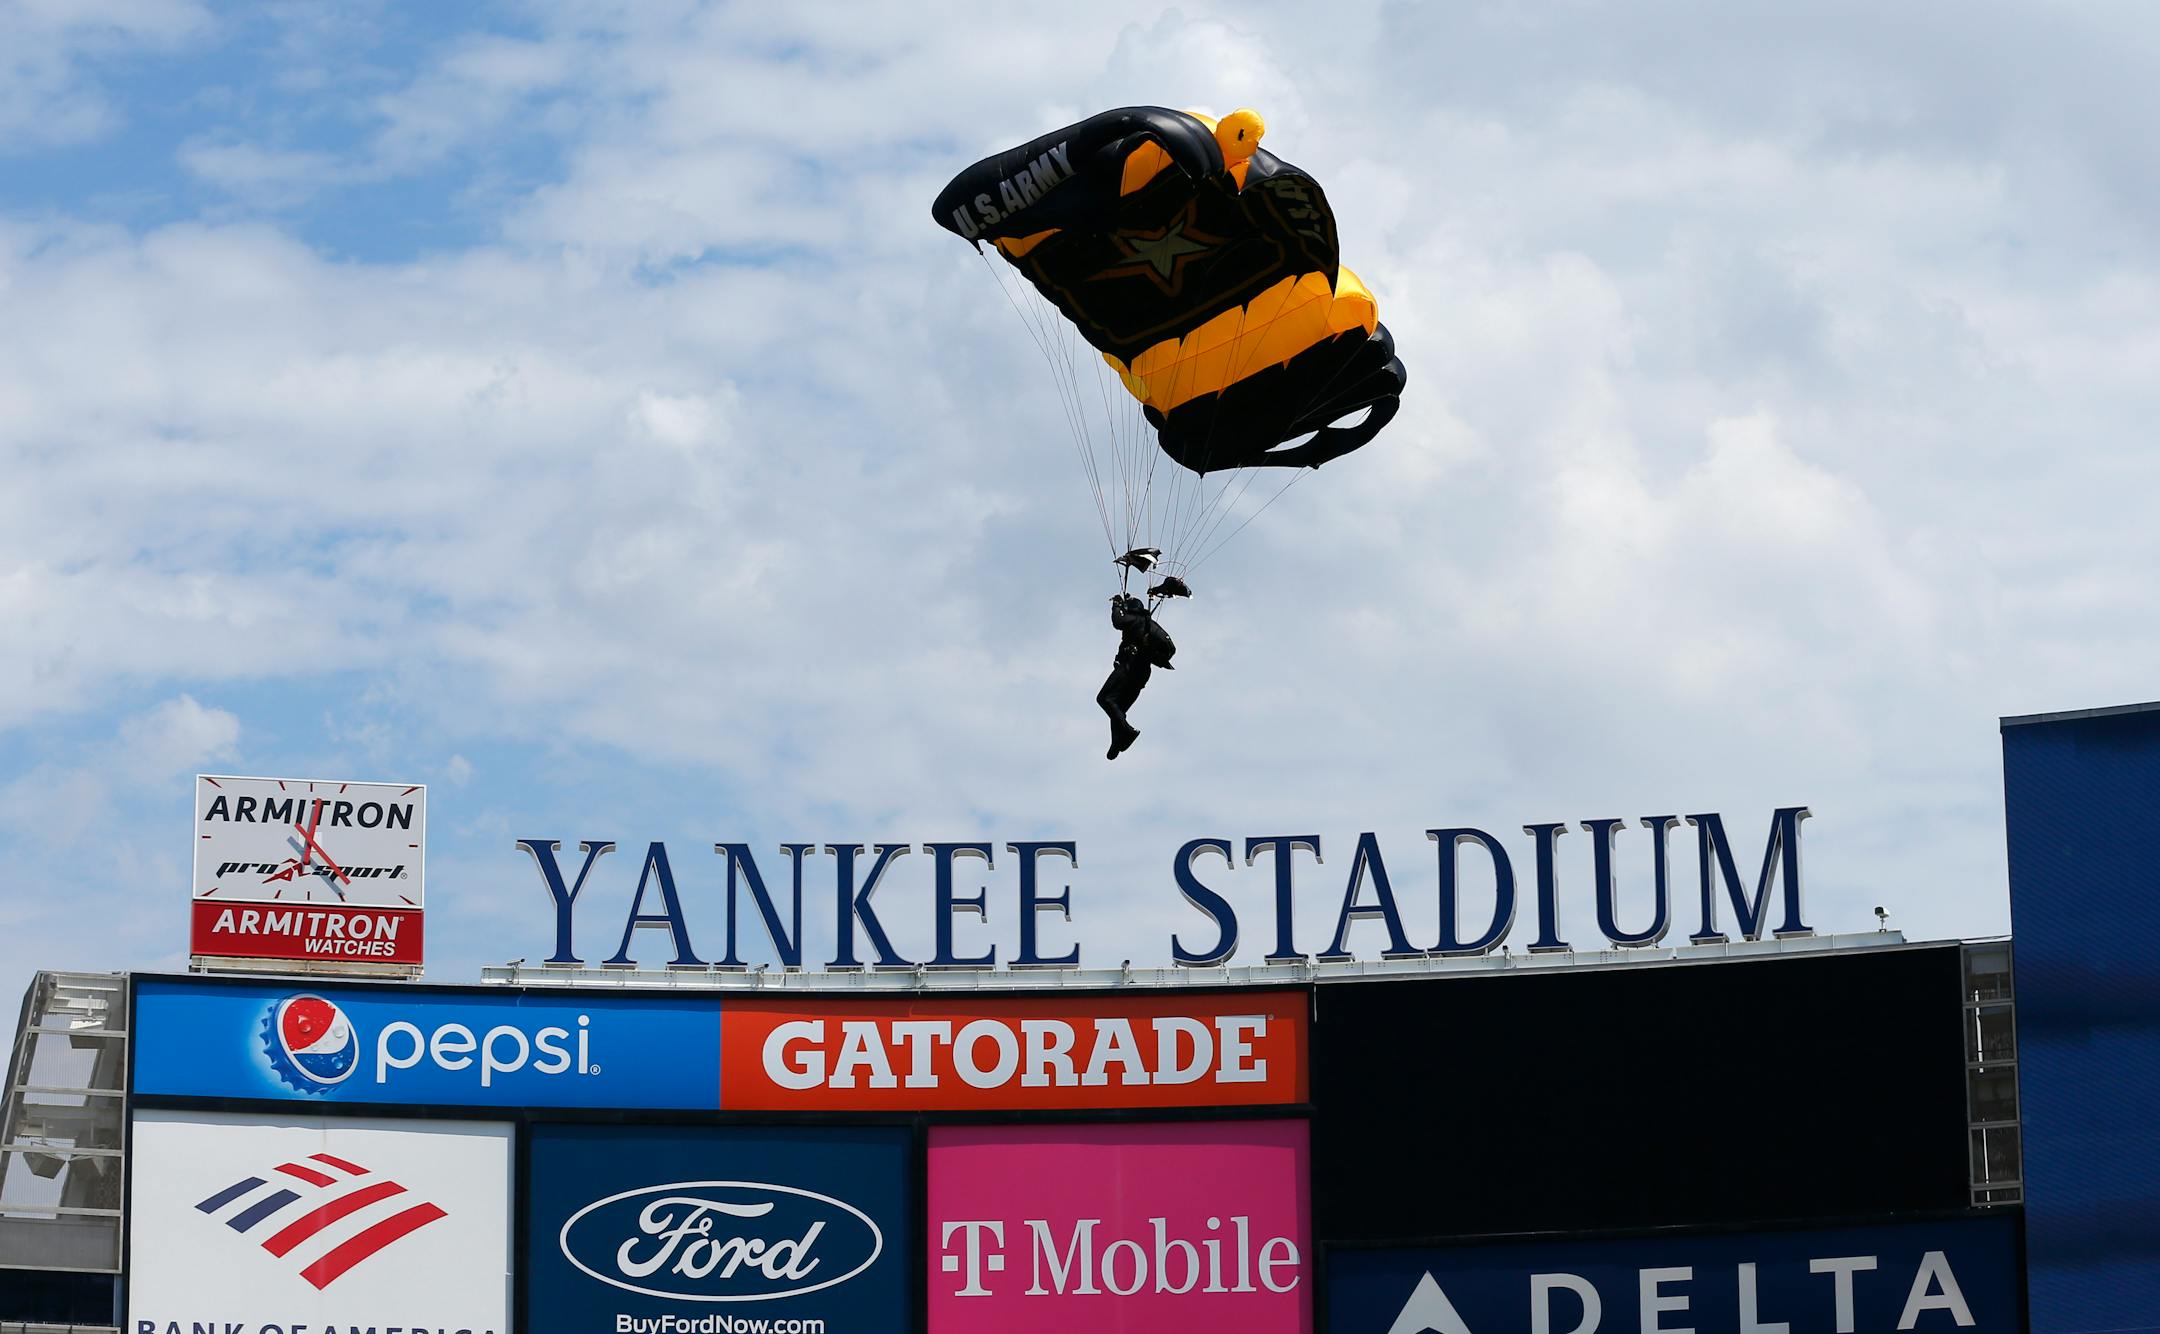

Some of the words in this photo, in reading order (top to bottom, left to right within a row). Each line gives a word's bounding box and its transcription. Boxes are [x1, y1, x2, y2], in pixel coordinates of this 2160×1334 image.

[204, 795, 414, 830] ARMITRON
[211, 908, 400, 940] ARMITRON
[515, 838, 1081, 968] YANKEE
[1170, 806, 1814, 967] STADIUM
[304, 938, 396, 957] WATCHES
[376, 1014, 590, 1088] pepsi
[762, 1015, 1268, 1091] GATORADE
[616, 1196, 827, 1280] Ford
[616, 1314, 825, 1334] BuyFordNow.com
[1530, 1250, 1977, 1334] DELTA
